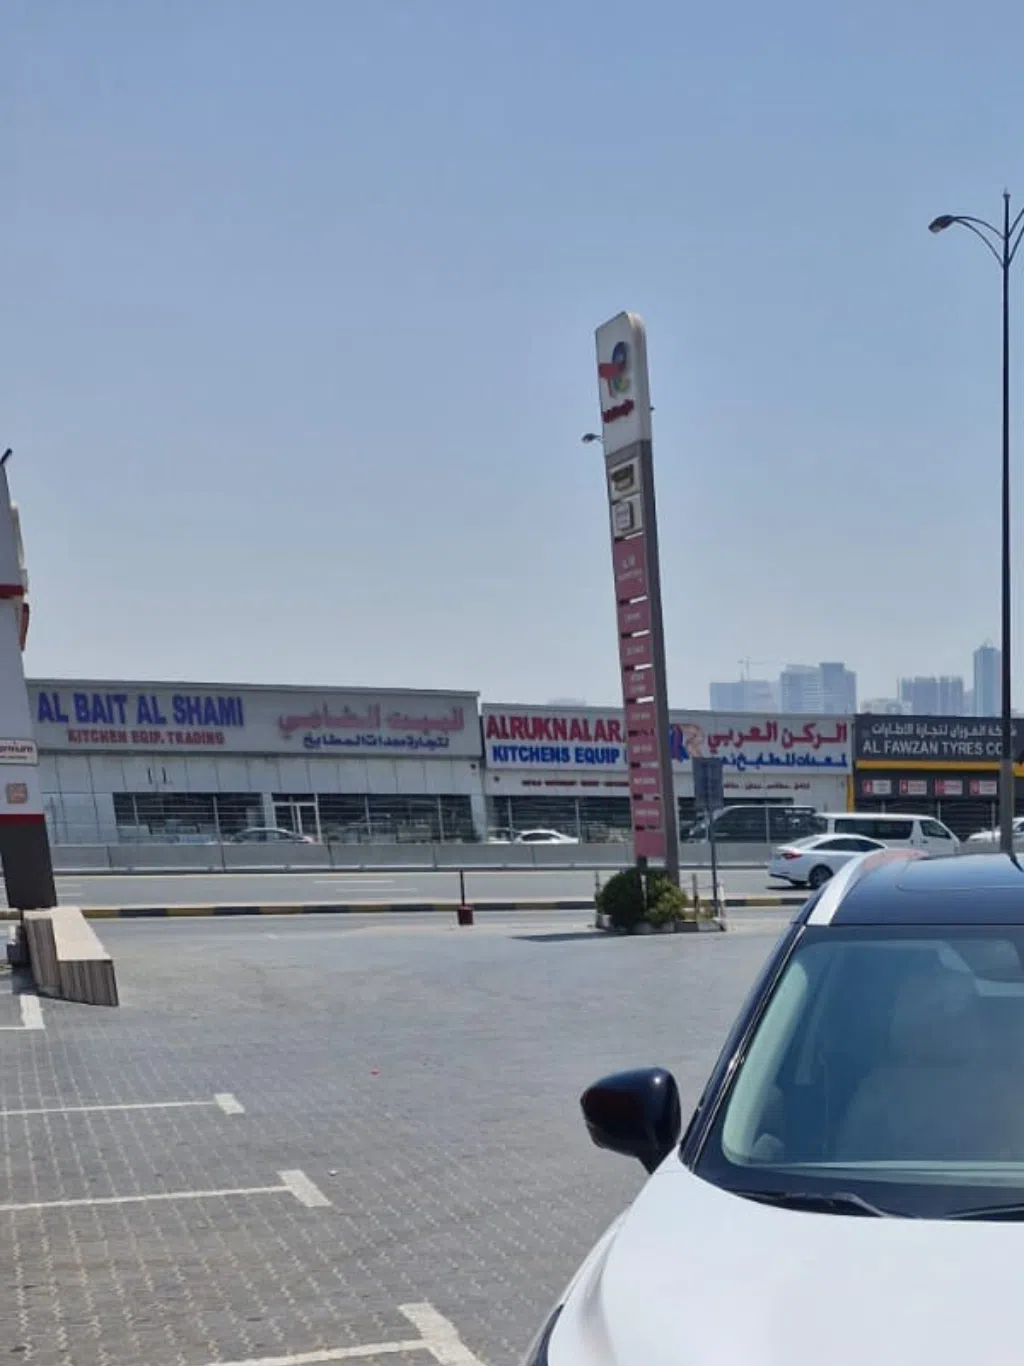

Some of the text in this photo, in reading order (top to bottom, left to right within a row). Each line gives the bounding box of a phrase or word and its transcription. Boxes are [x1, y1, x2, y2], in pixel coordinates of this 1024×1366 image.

[38, 692, 244, 727] AL BAIT AL SHAMI
[67, 729, 128, 743] KITCHEN
[708, 720, 847, 754] الركن العربي
[492, 745, 570, 762] KITCHENS
[575, 748, 620, 764] EQUIP
[863, 741, 880, 753] AL
[884, 741, 938, 754] FAWZAN
[942, 742, 983, 755] TYRES
